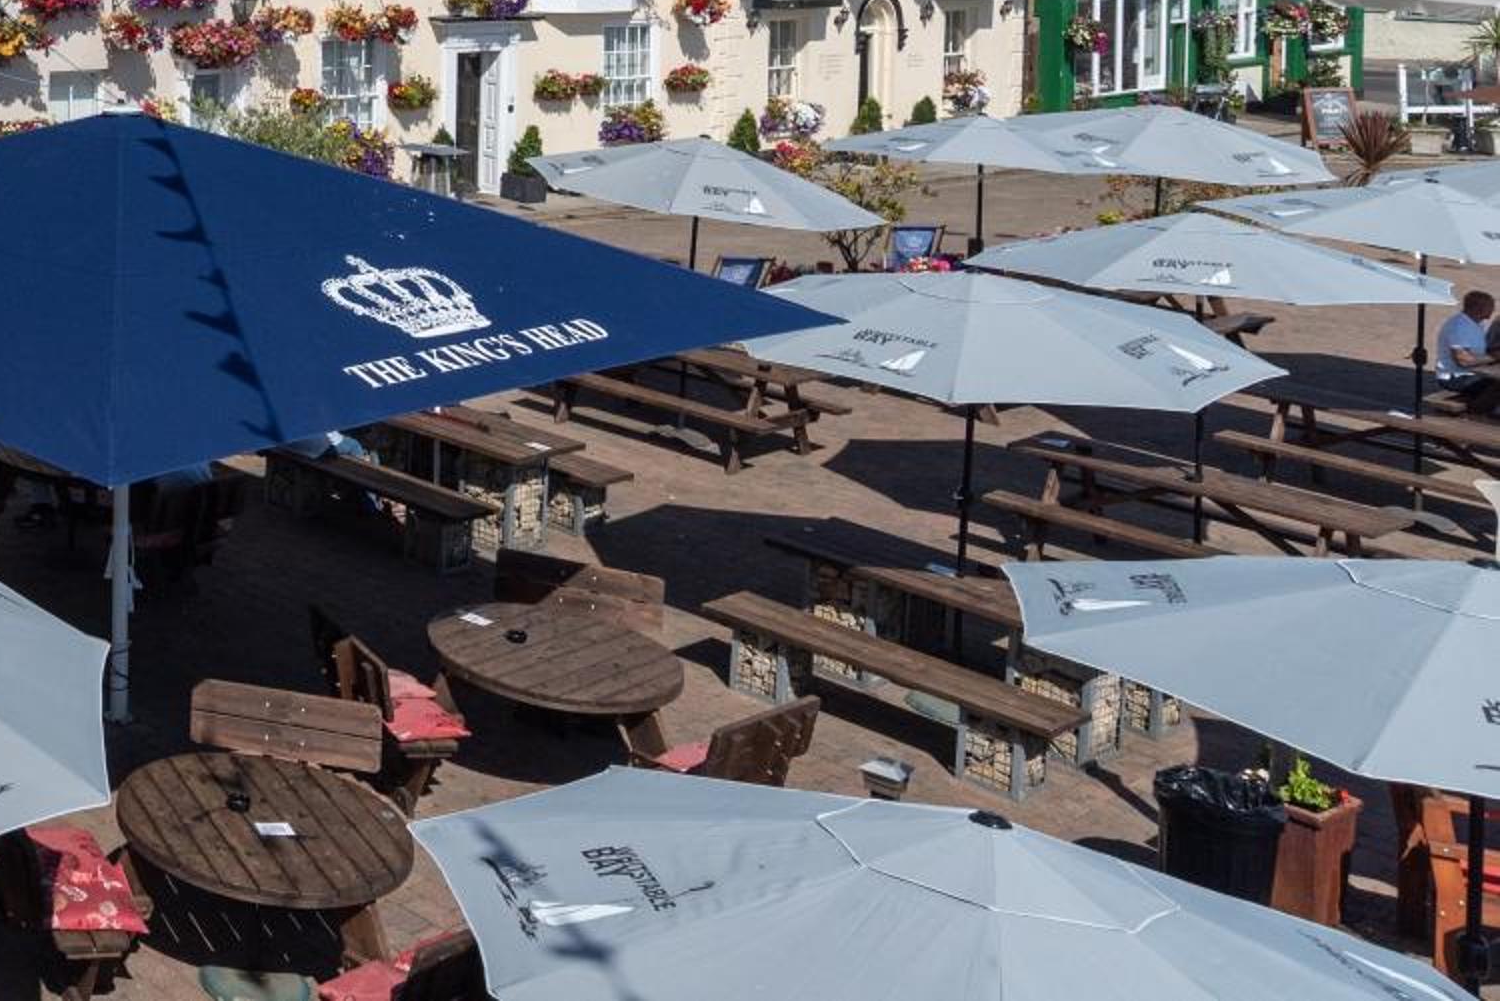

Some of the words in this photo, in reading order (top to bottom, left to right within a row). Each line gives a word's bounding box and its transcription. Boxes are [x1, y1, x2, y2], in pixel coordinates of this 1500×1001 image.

[343, 356, 428, 388] THE
[418, 334, 532, 373] KING'S
[519, 318, 609, 350] HEAD
[581, 846, 634, 877] BAY
